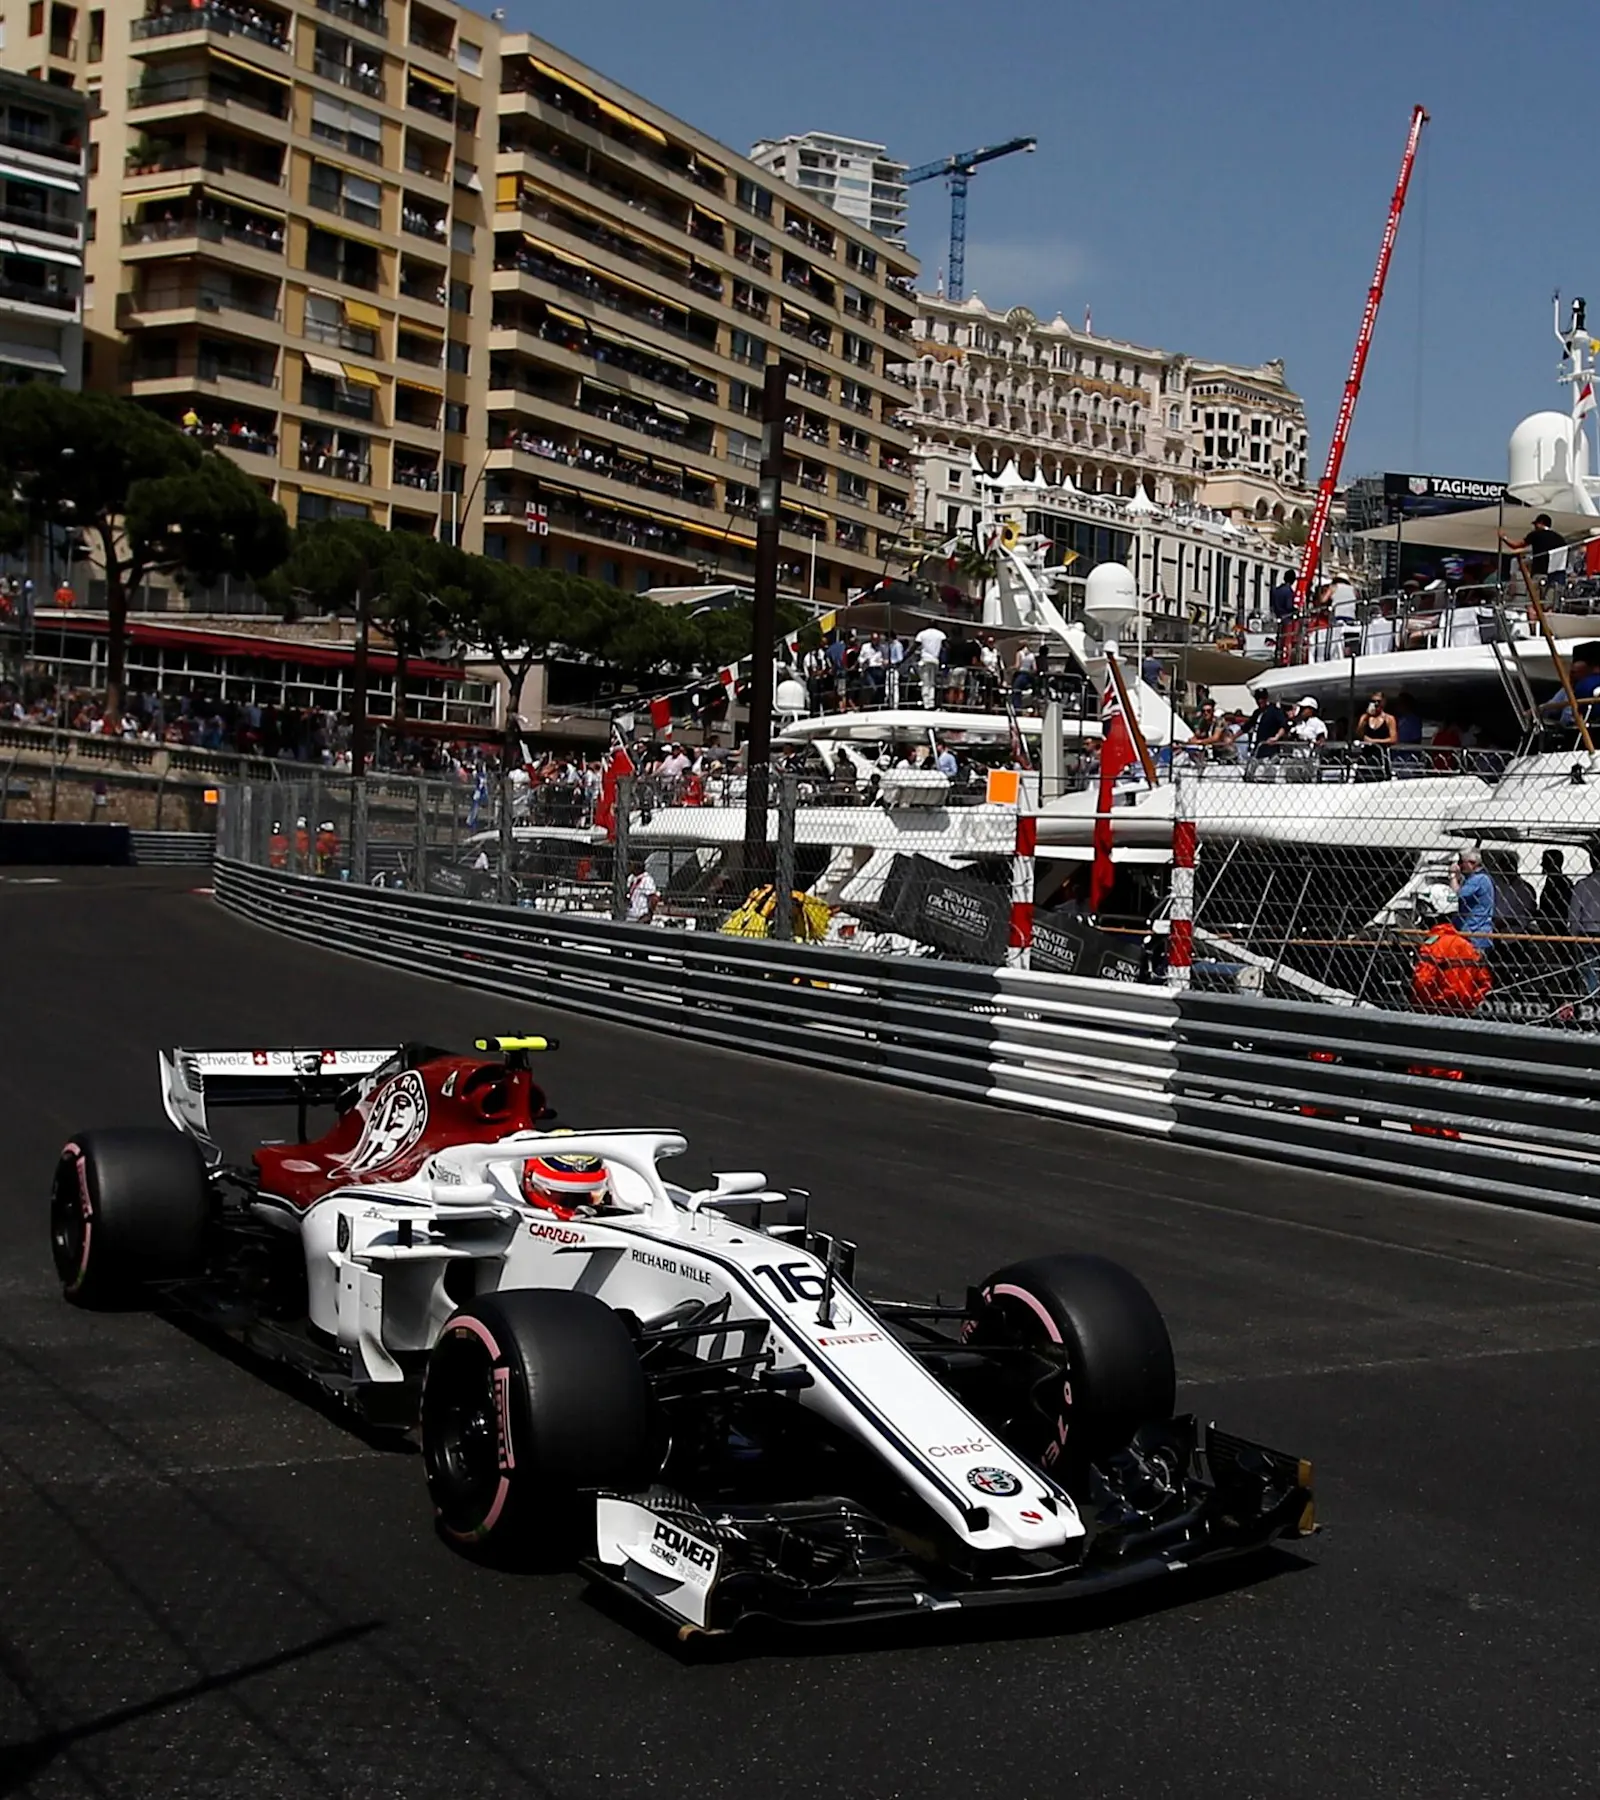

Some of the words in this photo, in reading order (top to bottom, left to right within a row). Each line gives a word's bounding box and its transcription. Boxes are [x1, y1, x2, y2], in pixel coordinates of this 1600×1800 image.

[927, 894, 965, 916] GRAND
[965, 909, 990, 927] PRIX
[942, 887, 982, 912] SENATE
[1031, 924, 1068, 948] SENATE
[1030, 937, 1054, 953] AND
[1053, 946, 1076, 962] PRIX
[199, 1052, 248, 1066] chweiz
[340, 1051, 391, 1065] Svizzer
[529, 1222, 586, 1245] CARRERA
[631, 1250, 677, 1274] RICHARD
[679, 1264, 712, 1285] MILLE
[752, 1262, 835, 1303] 16
[928, 1440, 987, 1458] Claro
[653, 1521, 716, 1572] POWER
